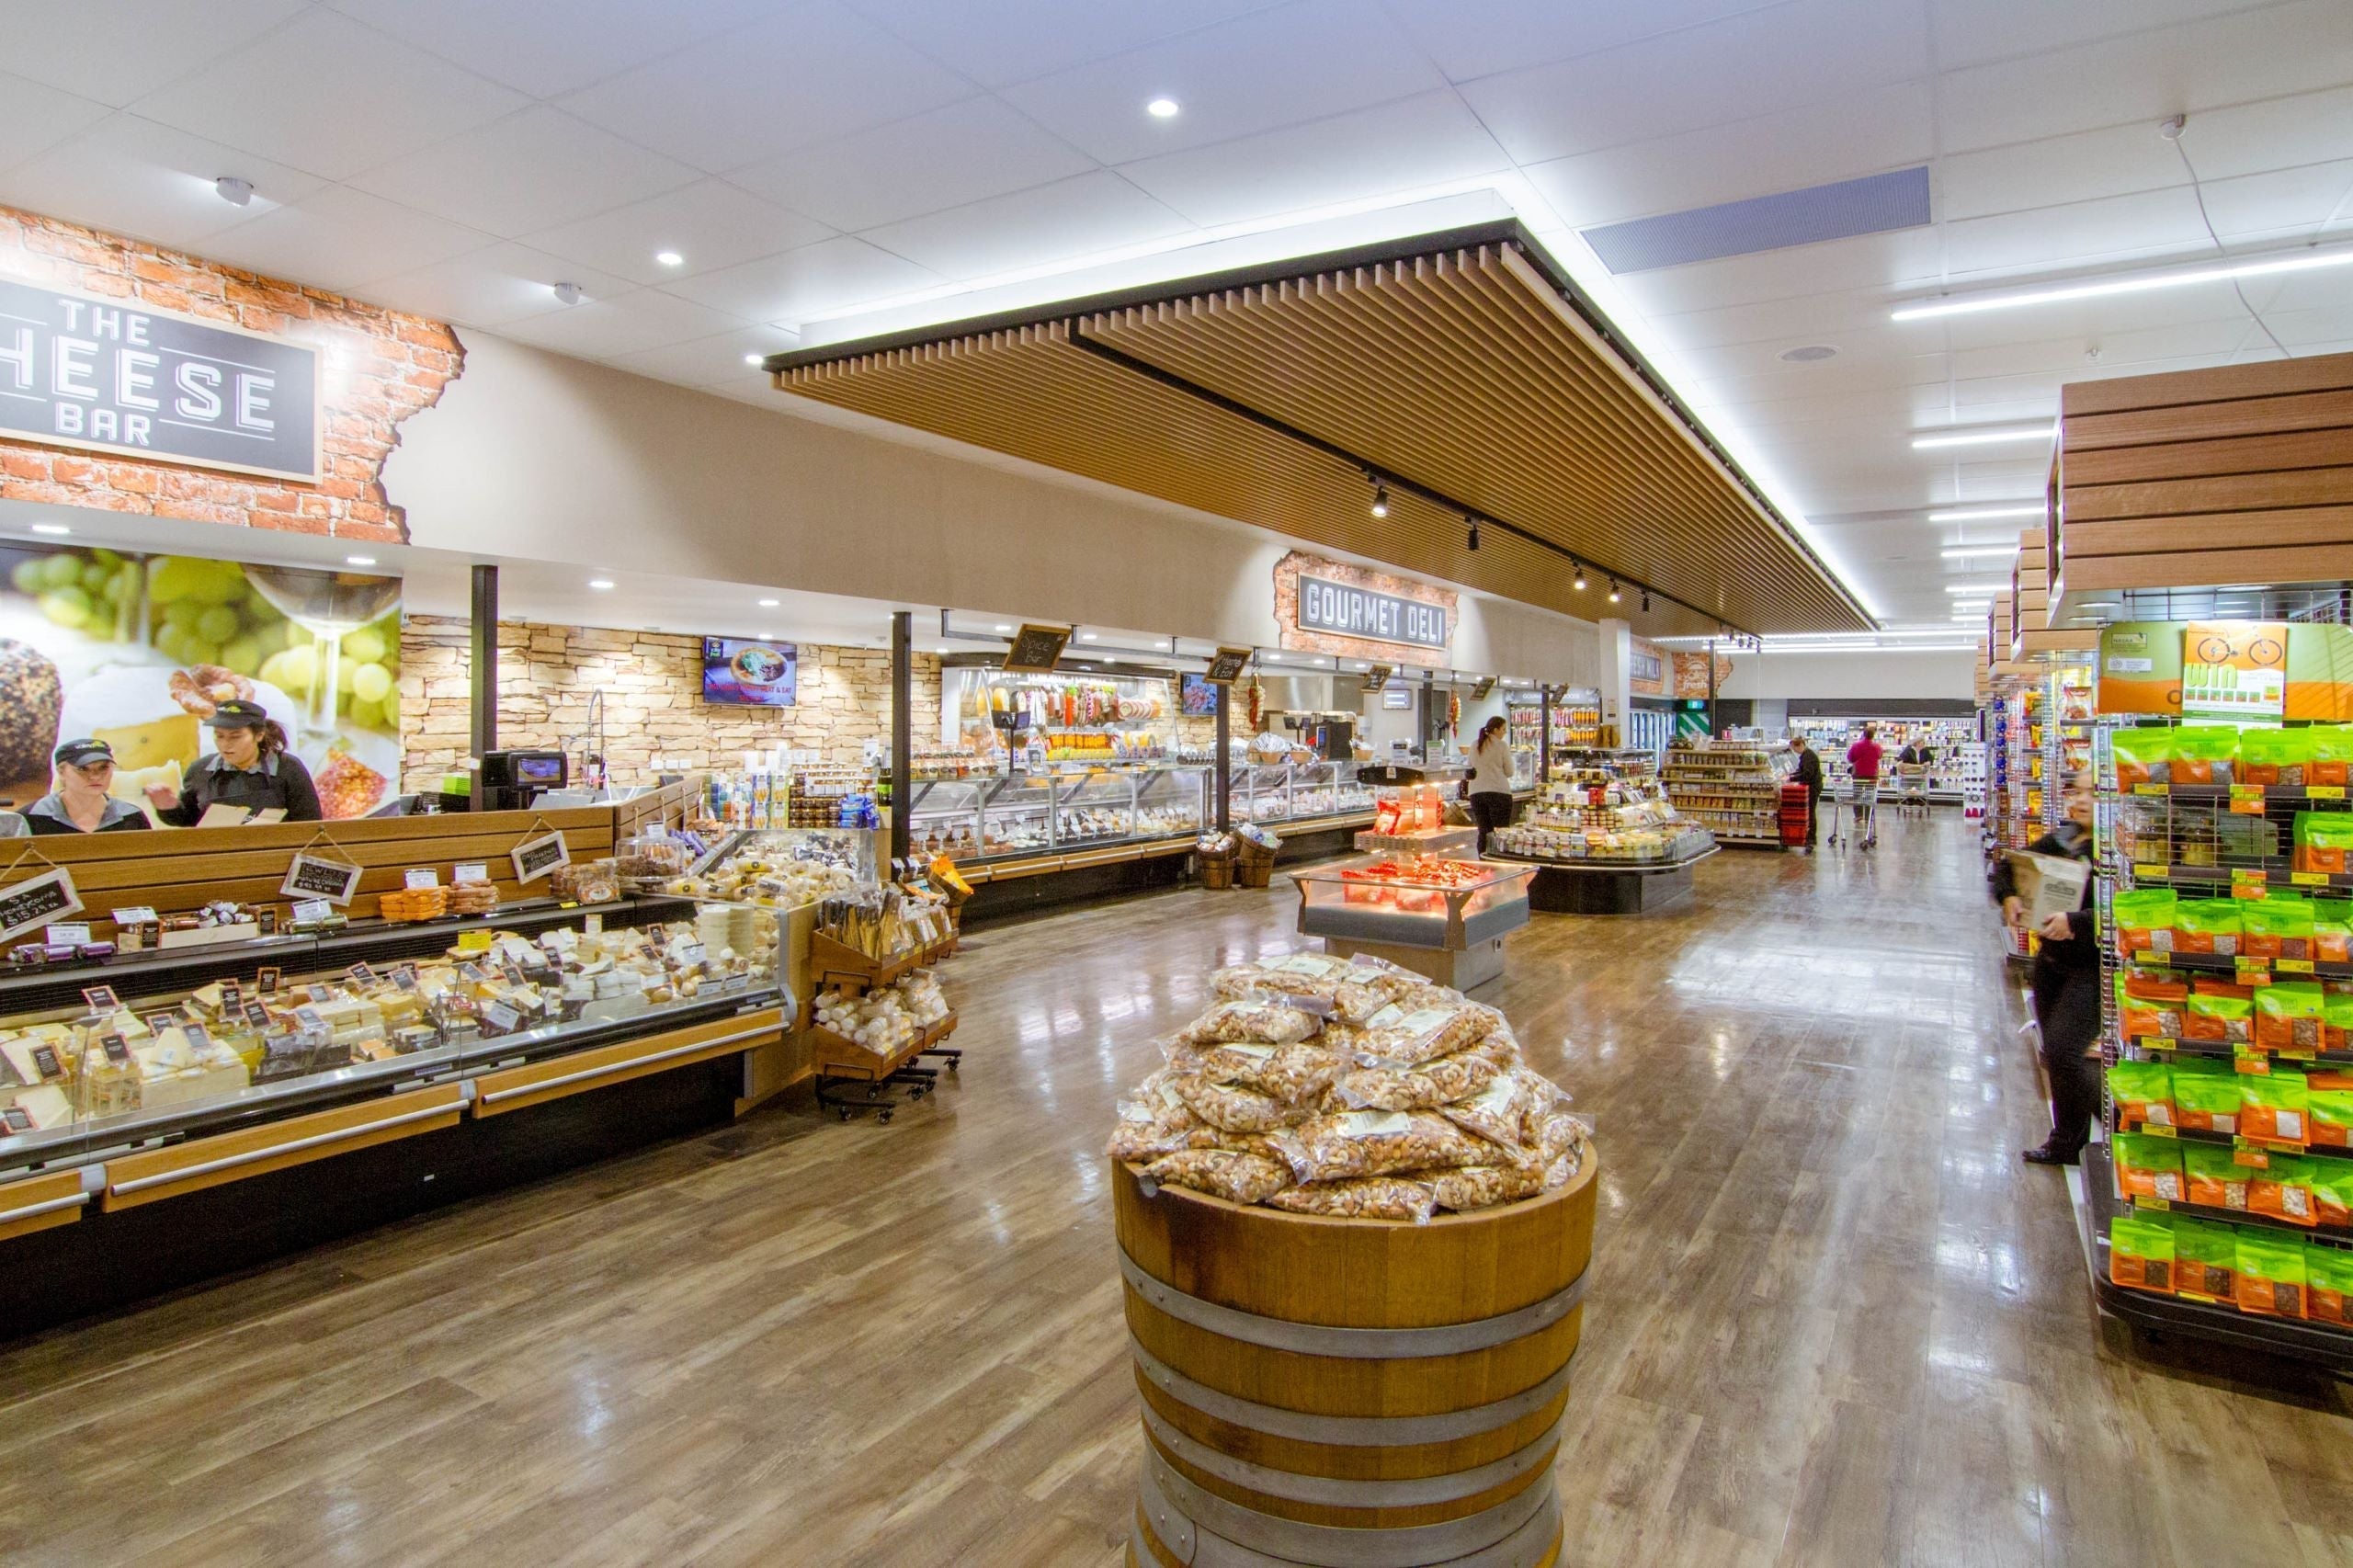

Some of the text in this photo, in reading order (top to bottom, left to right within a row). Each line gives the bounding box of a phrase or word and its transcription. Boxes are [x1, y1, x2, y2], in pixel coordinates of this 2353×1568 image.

[58, 299, 151, 347] THE
[55, 402, 151, 446] BAR
[1306, 583, 1442, 643] GOURMET DELI
